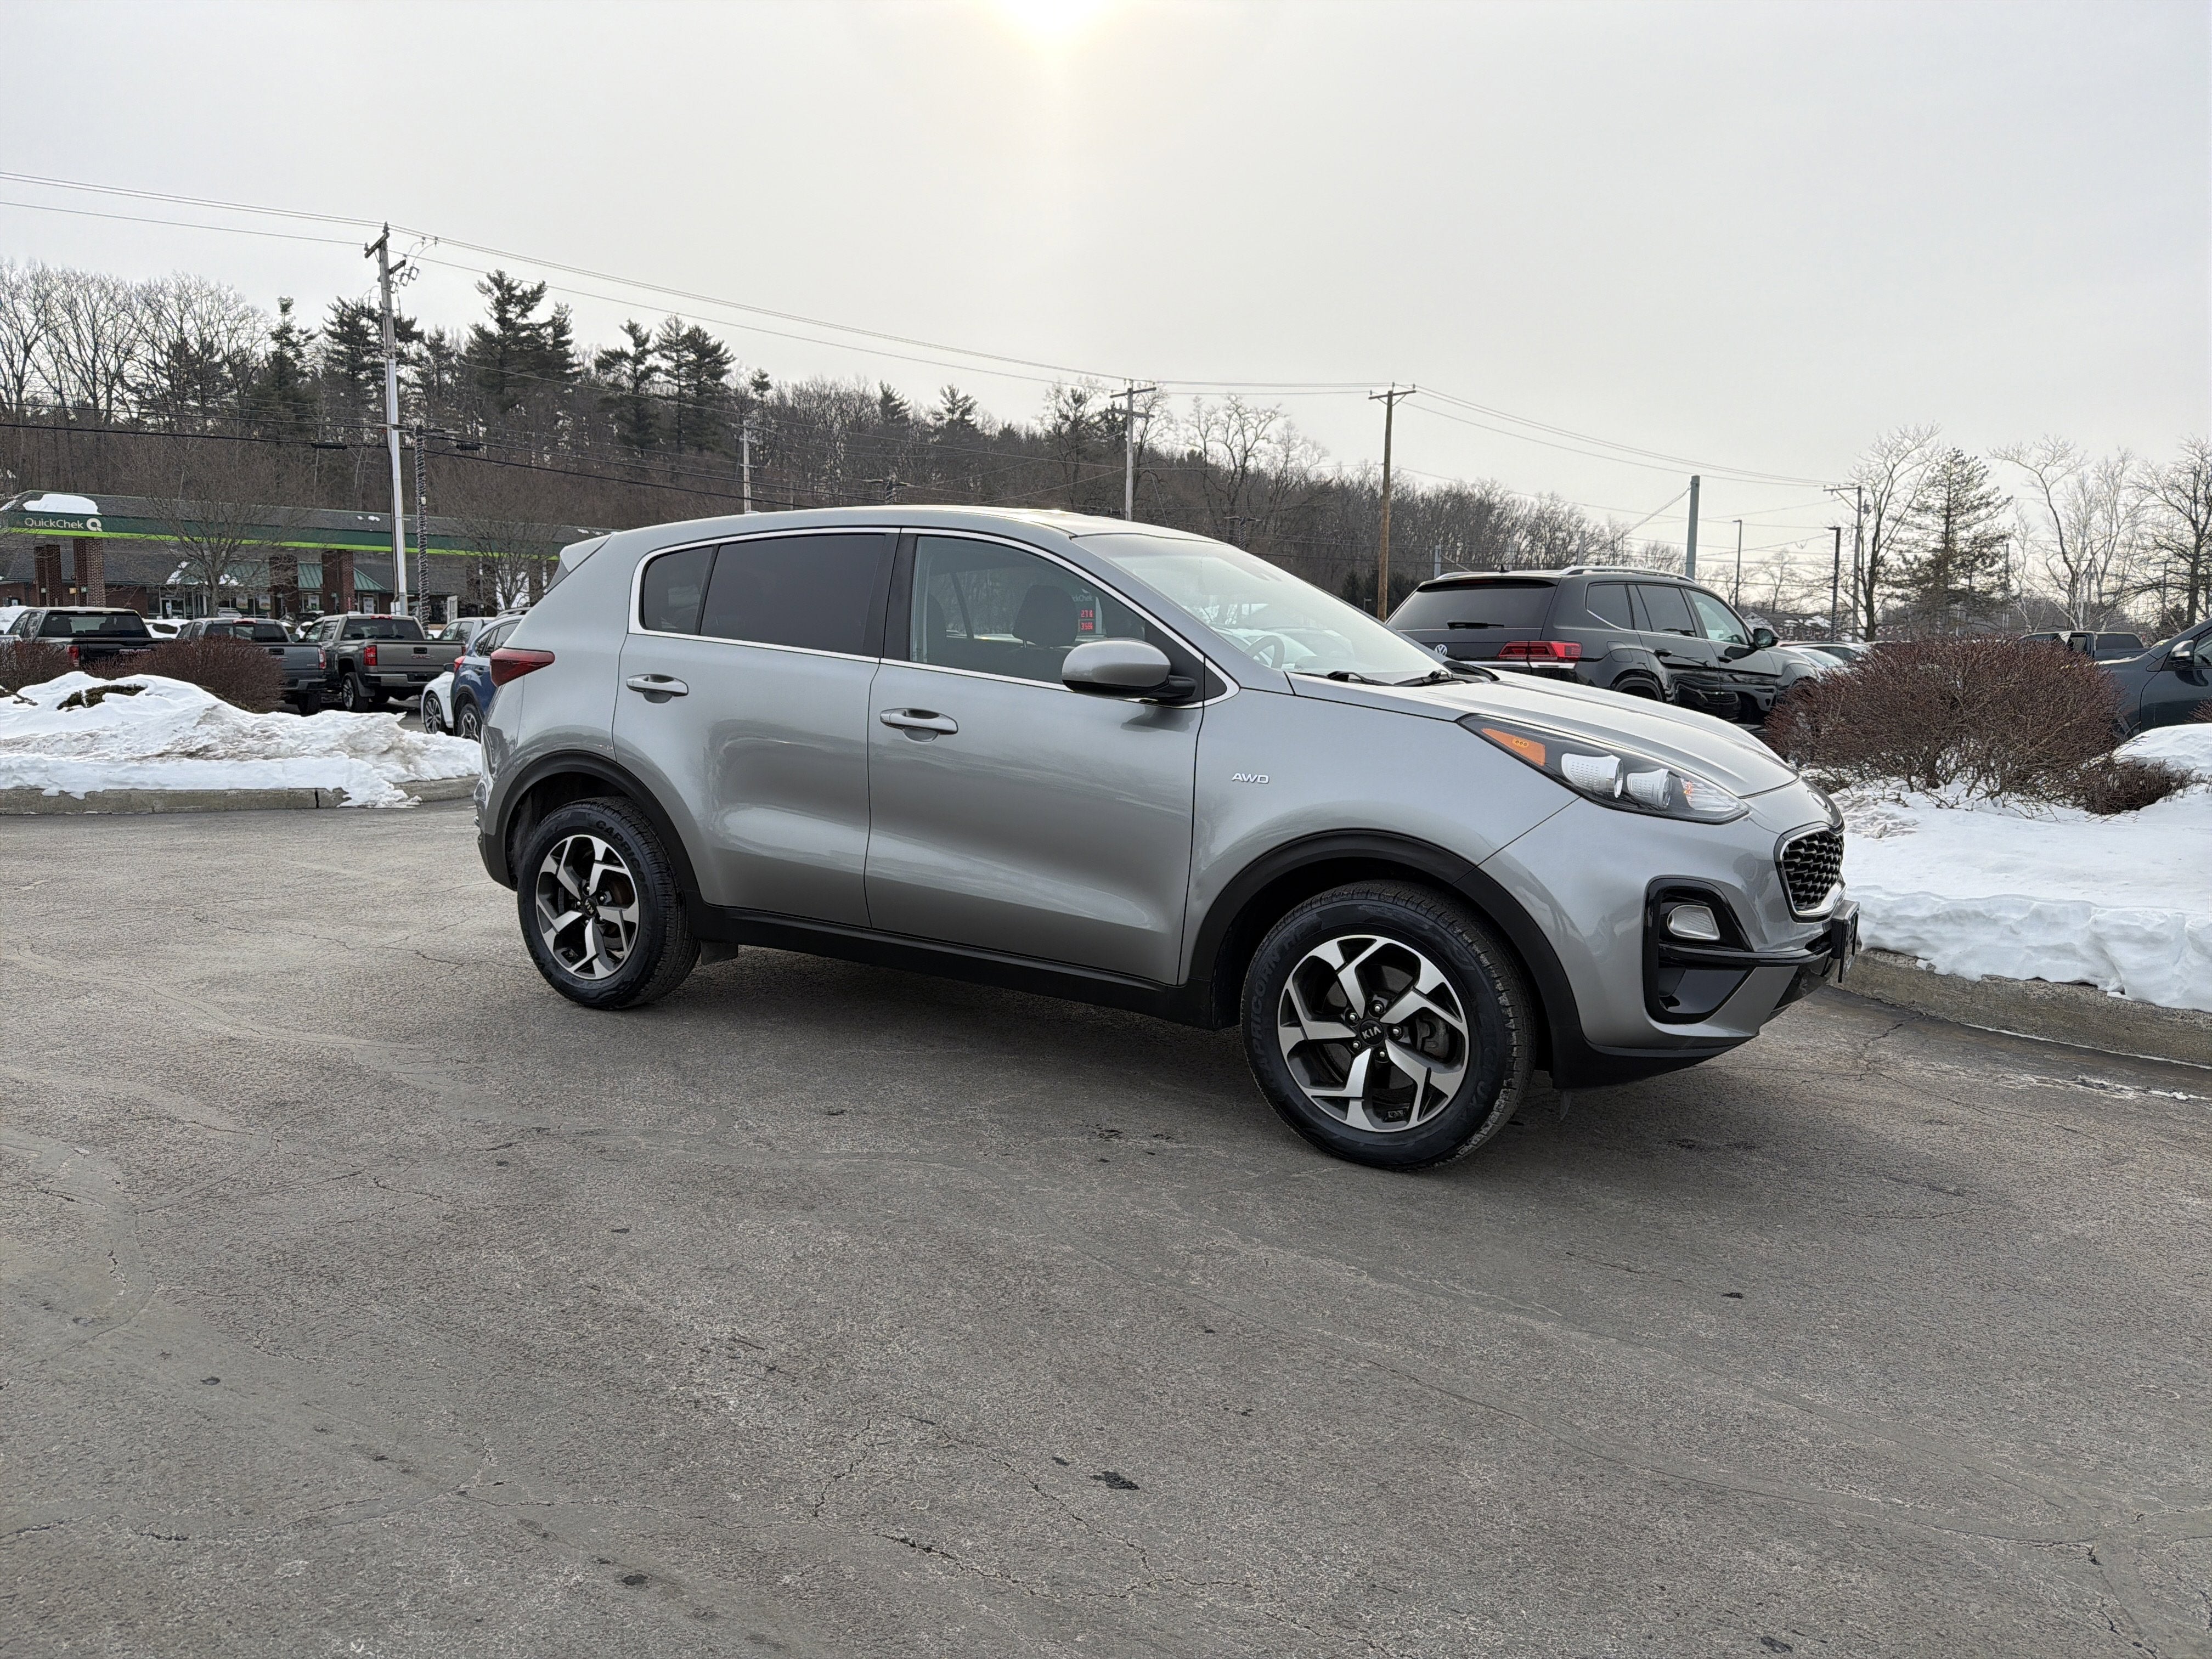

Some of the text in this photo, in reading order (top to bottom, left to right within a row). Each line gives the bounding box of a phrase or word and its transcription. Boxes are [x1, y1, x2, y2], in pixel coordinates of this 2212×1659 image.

[24, 517, 84, 529] QuickChek
[1231, 772, 1269, 784] AWD
[1361, 1026, 1382, 1040] KIA
